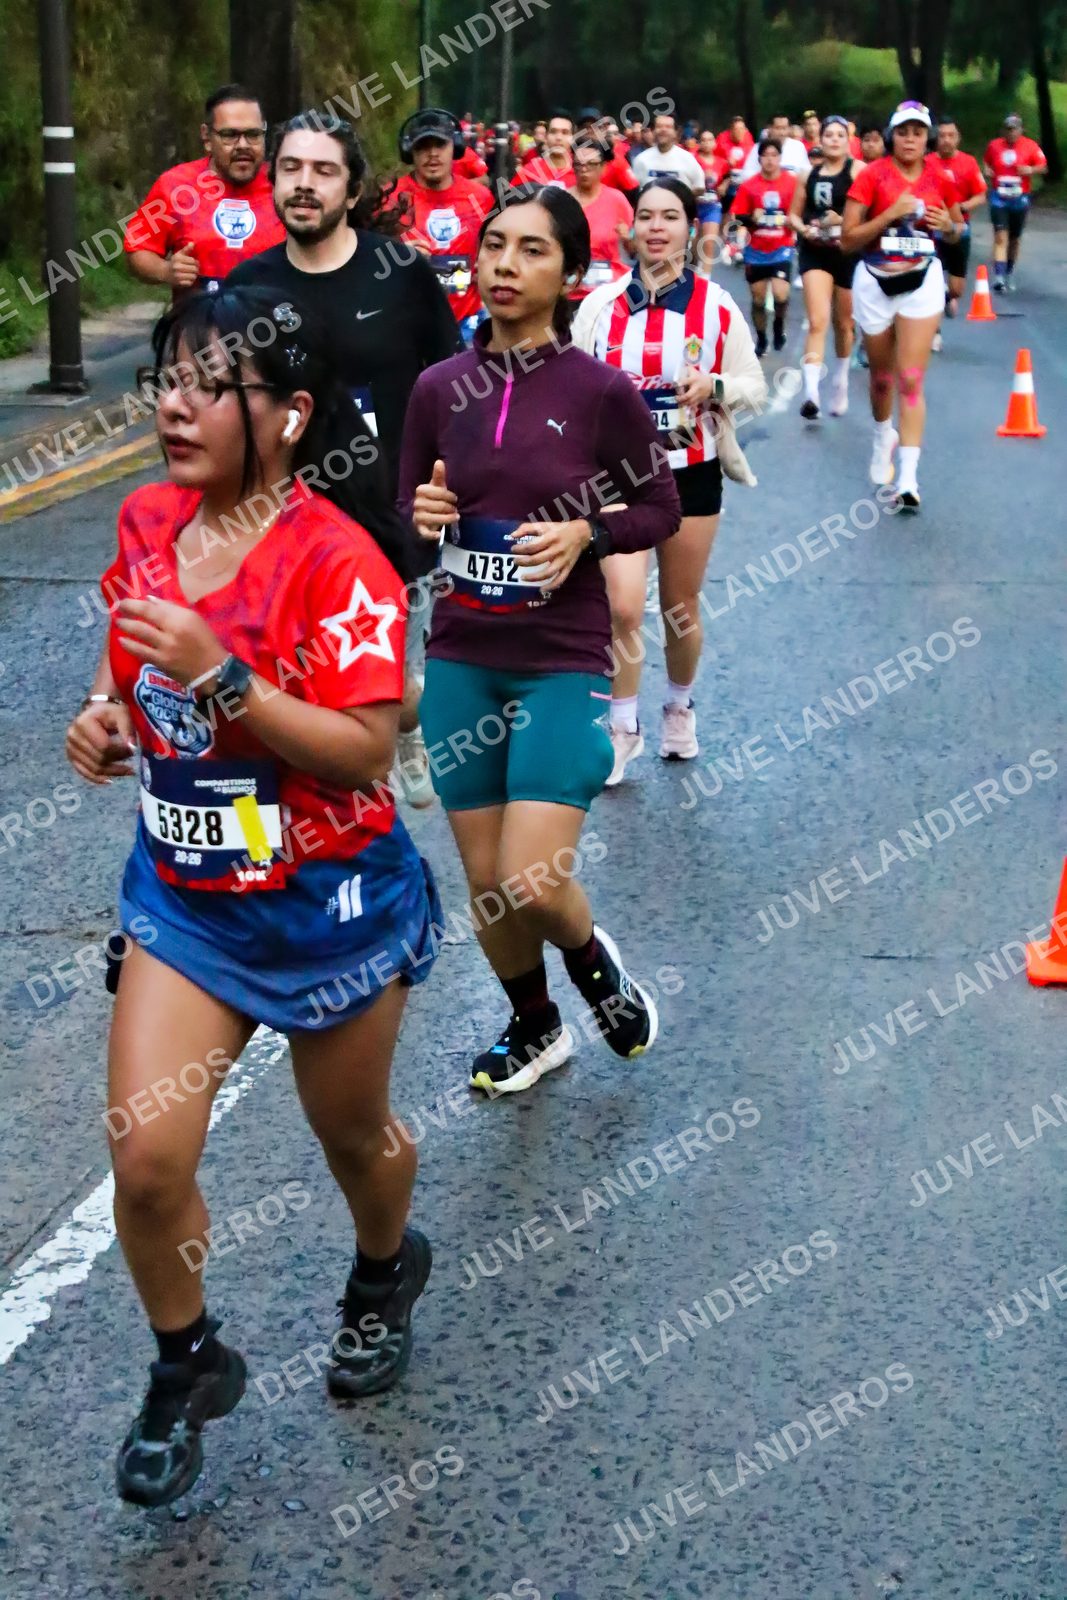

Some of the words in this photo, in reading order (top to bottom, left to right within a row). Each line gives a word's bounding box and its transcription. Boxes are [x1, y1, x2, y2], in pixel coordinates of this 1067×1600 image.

[467, 553, 519, 582] 4732
[157, 802, 224, 846] 5328
[237, 870, 267, 882] 10K
